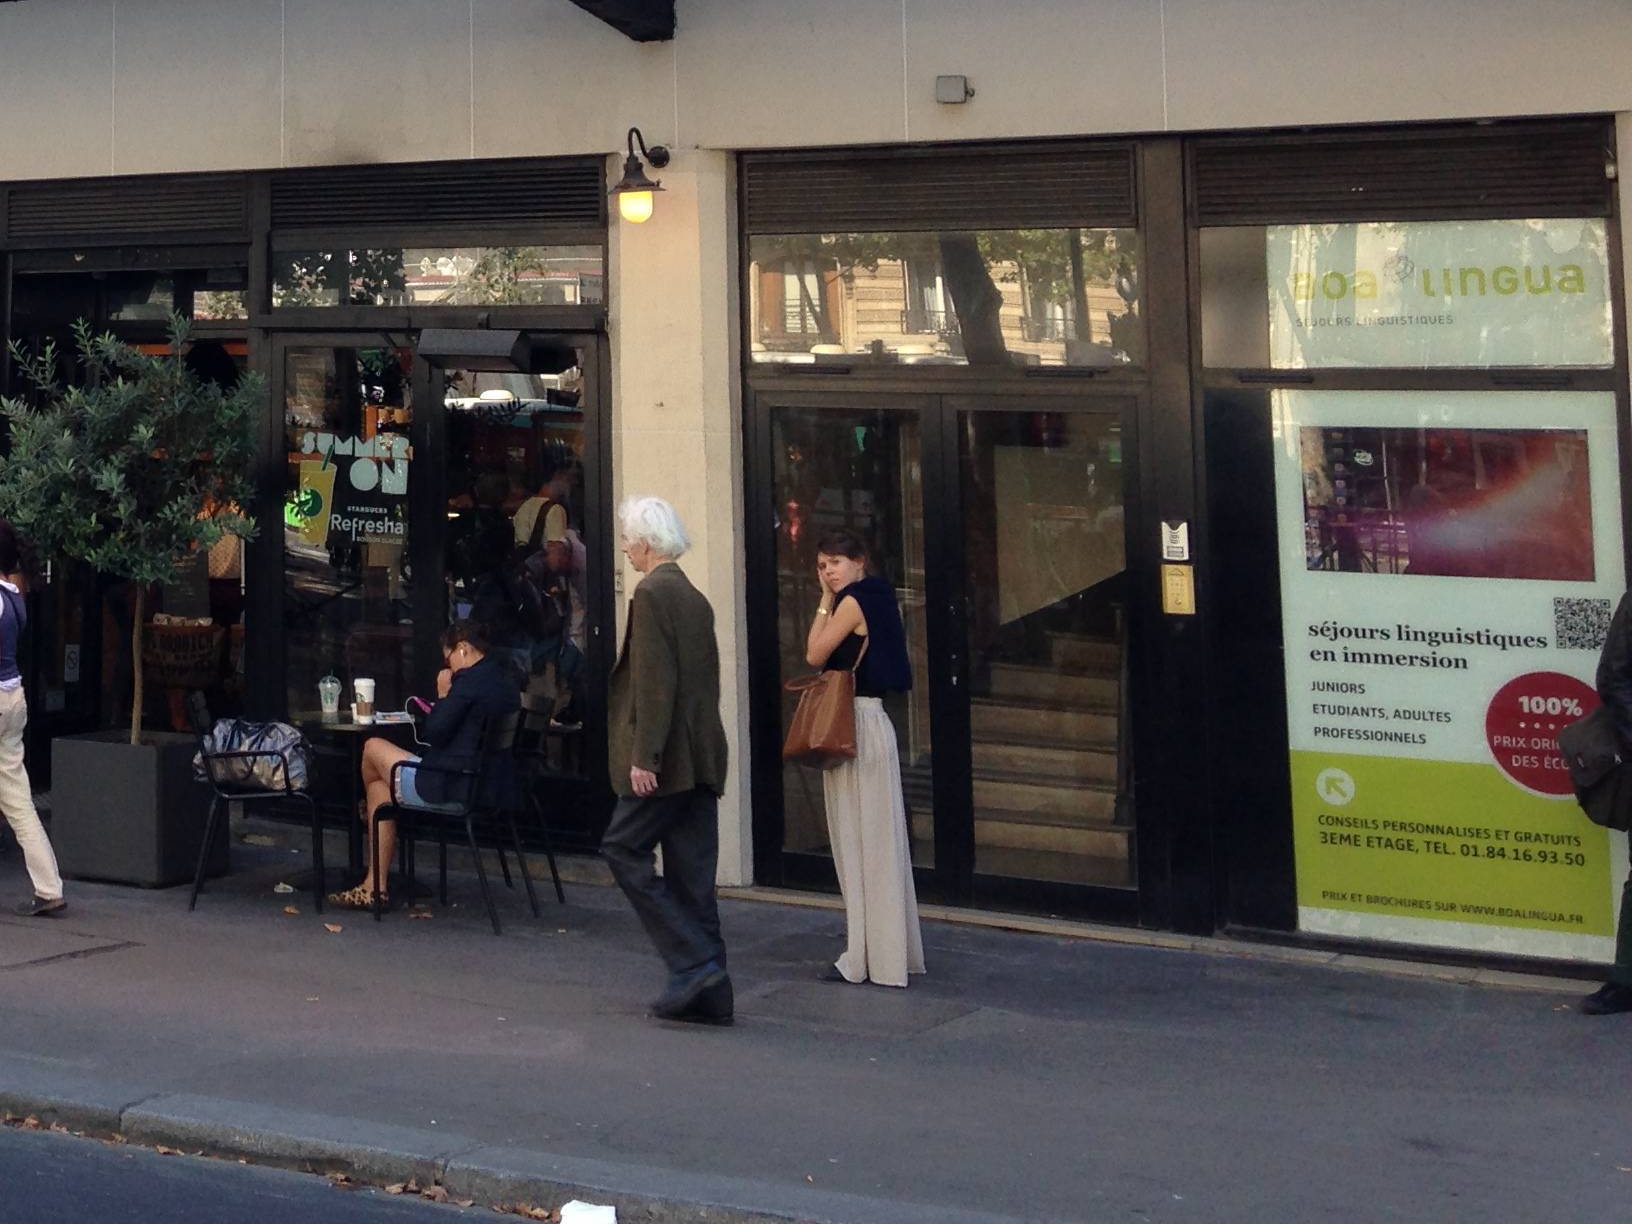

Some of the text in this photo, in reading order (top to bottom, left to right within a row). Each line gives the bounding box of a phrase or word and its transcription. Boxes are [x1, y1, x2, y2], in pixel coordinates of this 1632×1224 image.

[301, 431, 410, 458] SUMMER
[350, 457, 409, 494] ON
[1308, 620, 1548, 651] séjours linguistiques
[1309, 645, 1468, 669] en immersion
[1311, 680, 1366, 695] JUNIORS
[1312, 703, 1452, 723] ETUDIANTS, ADULTES
[1517, 695, 1584, 717] 100%
[1313, 726, 1427, 745] PROFESSIONNELS
[1493, 735, 1527, 749] PRIX
[1511, 754, 1539, 768] DES
[1318, 814, 1582, 847] CONSEILS PERSONNALISES ET GRATUITS
[1320, 831, 1585, 867] 3EME ETAGE, TEL. 01.84.16.93.50
[1322, 890, 1584, 925] PRIX ET BROCHURES SUR WWW.BOALINGUA.FR
